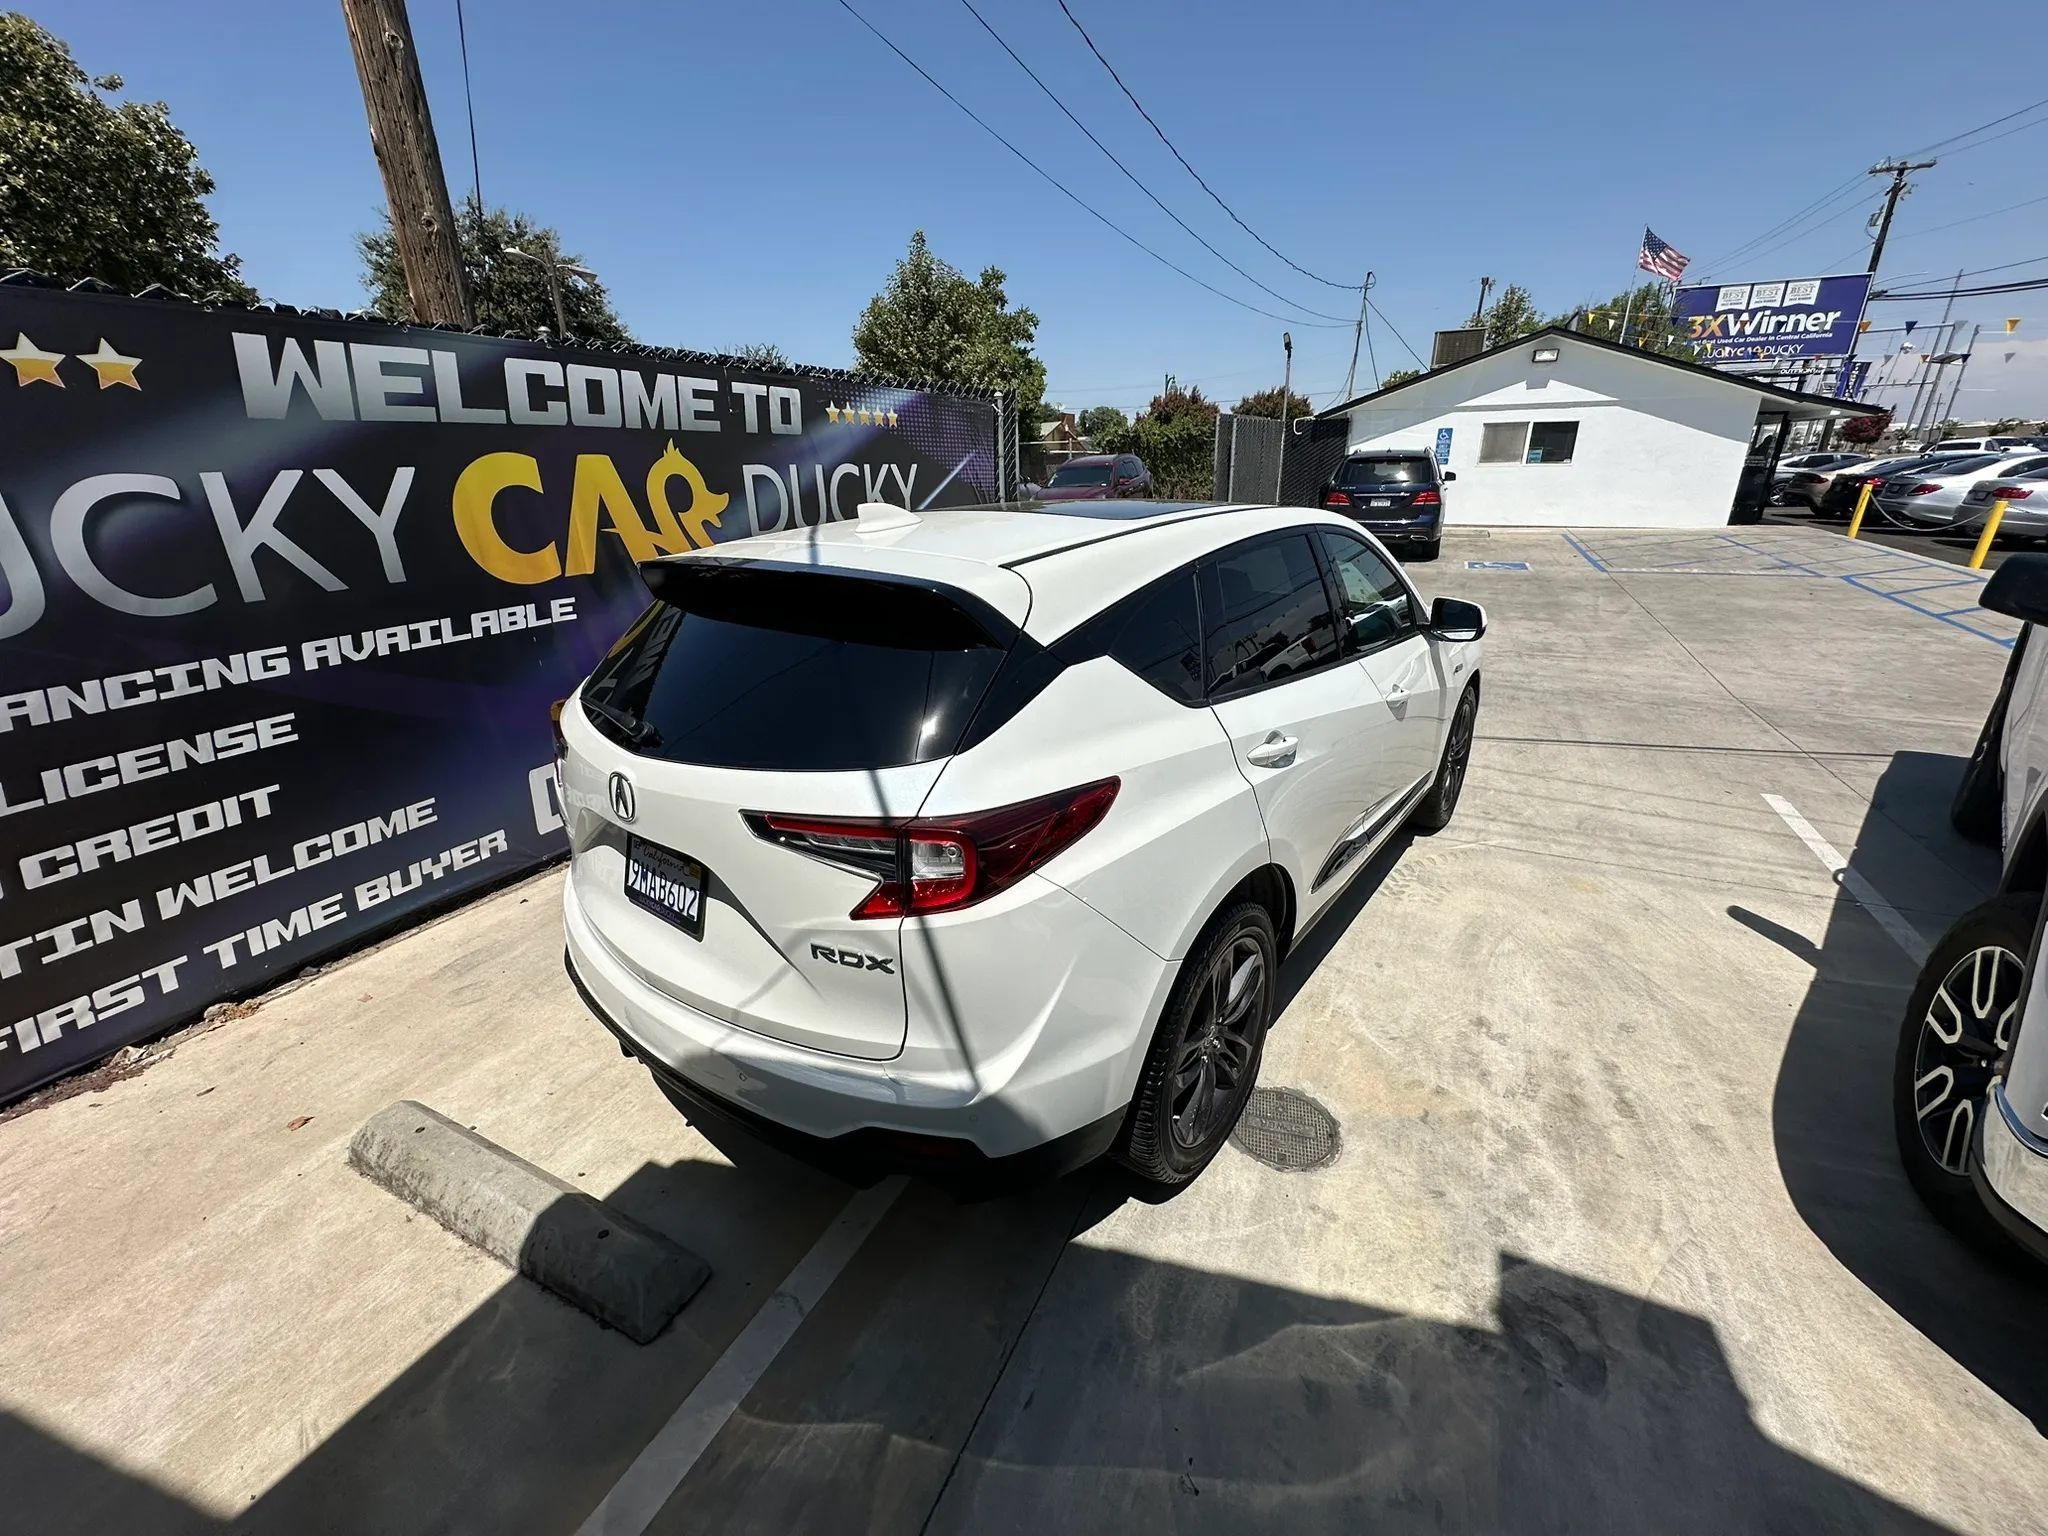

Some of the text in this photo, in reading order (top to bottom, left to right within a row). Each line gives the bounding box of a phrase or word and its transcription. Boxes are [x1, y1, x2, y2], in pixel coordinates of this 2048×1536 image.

[232, 332, 803, 435] WELCOME TO
[742, 463, 918, 537] DUCKY
[302, 598, 577, 671] AVAILABLE
[19, 784, 281, 890] CREDIT
[156, 797, 439, 920] WELCOME
[203, 892, 347, 970] TIME
[355, 828, 508, 912] BUYER
[630, 858, 698, 921] 9MAB602
[809, 942, 896, 976] RDX
